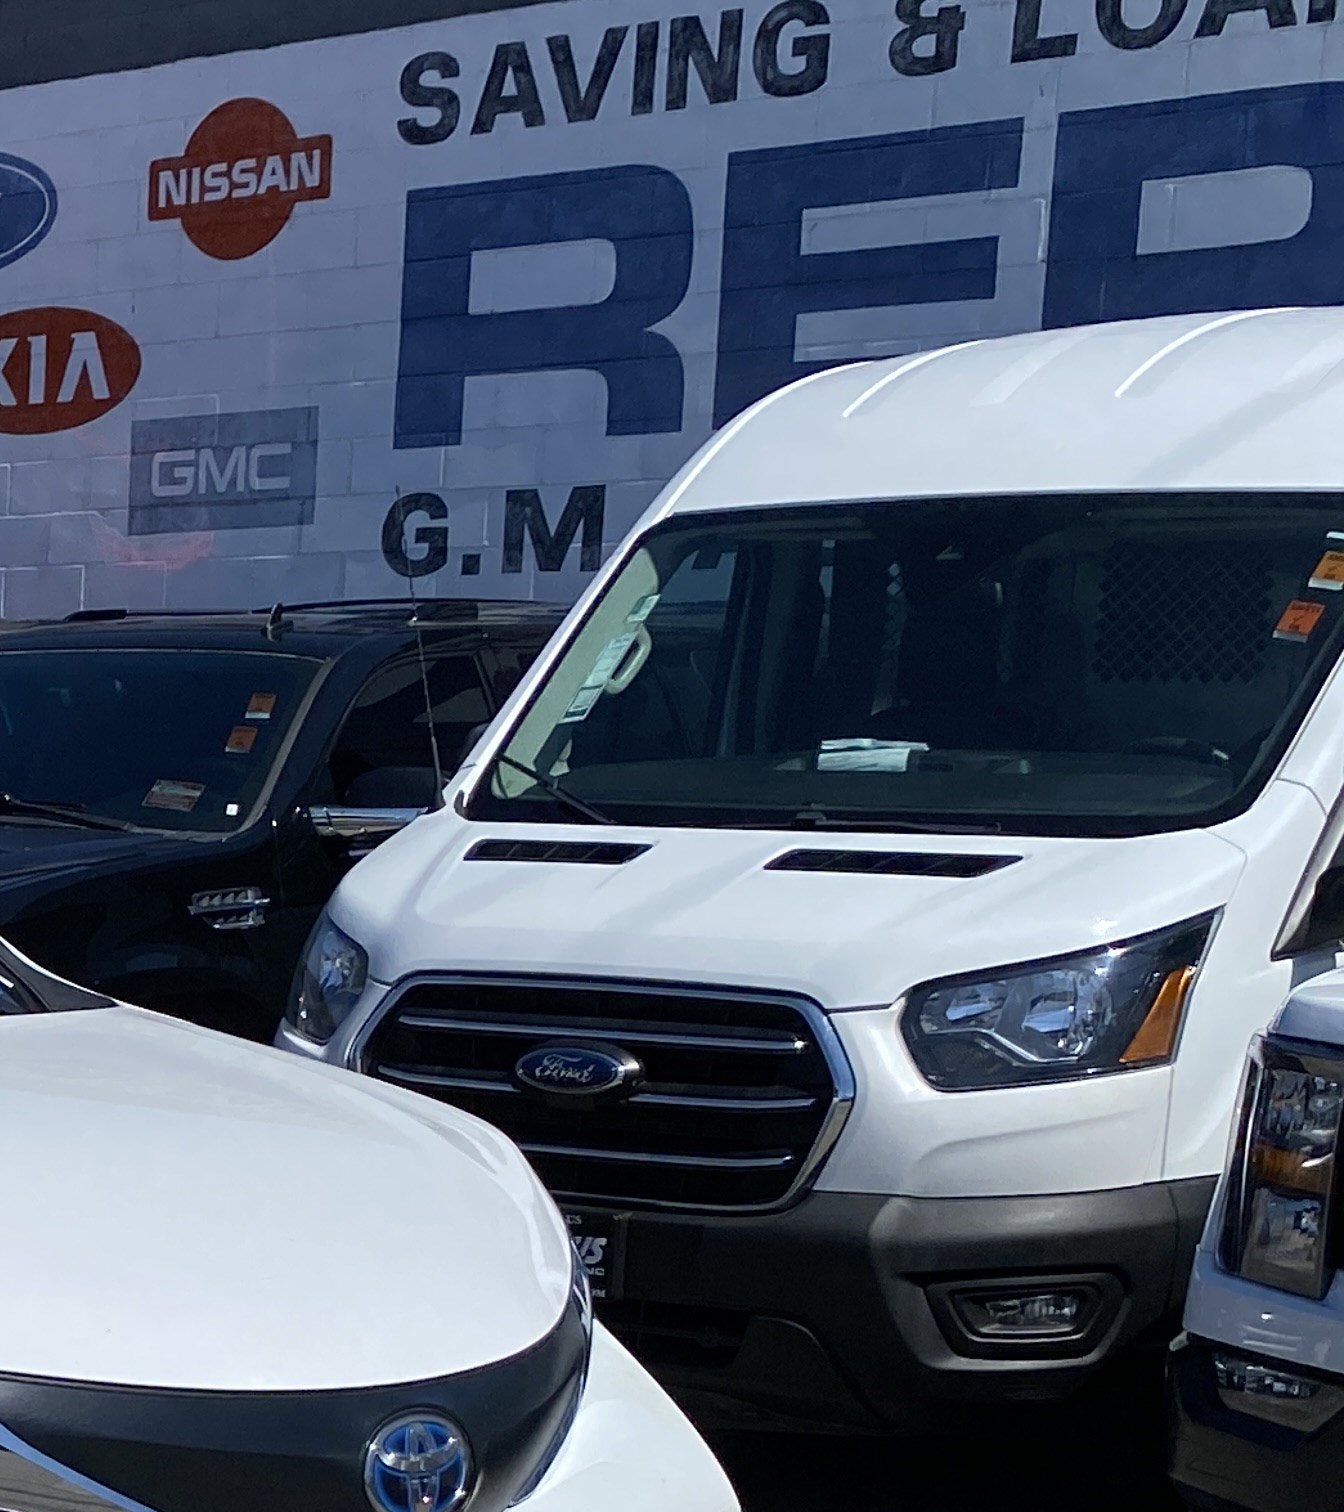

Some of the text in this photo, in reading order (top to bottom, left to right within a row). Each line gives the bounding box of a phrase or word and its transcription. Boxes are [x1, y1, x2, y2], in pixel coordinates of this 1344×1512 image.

[397, 0, 831, 146] SAVING
[889, 0, 966, 77] &
[156, 148, 322, 209] NISSAN
[149, 442, 293, 498] GMC
[534, 1053, 596, 1083] Ford
